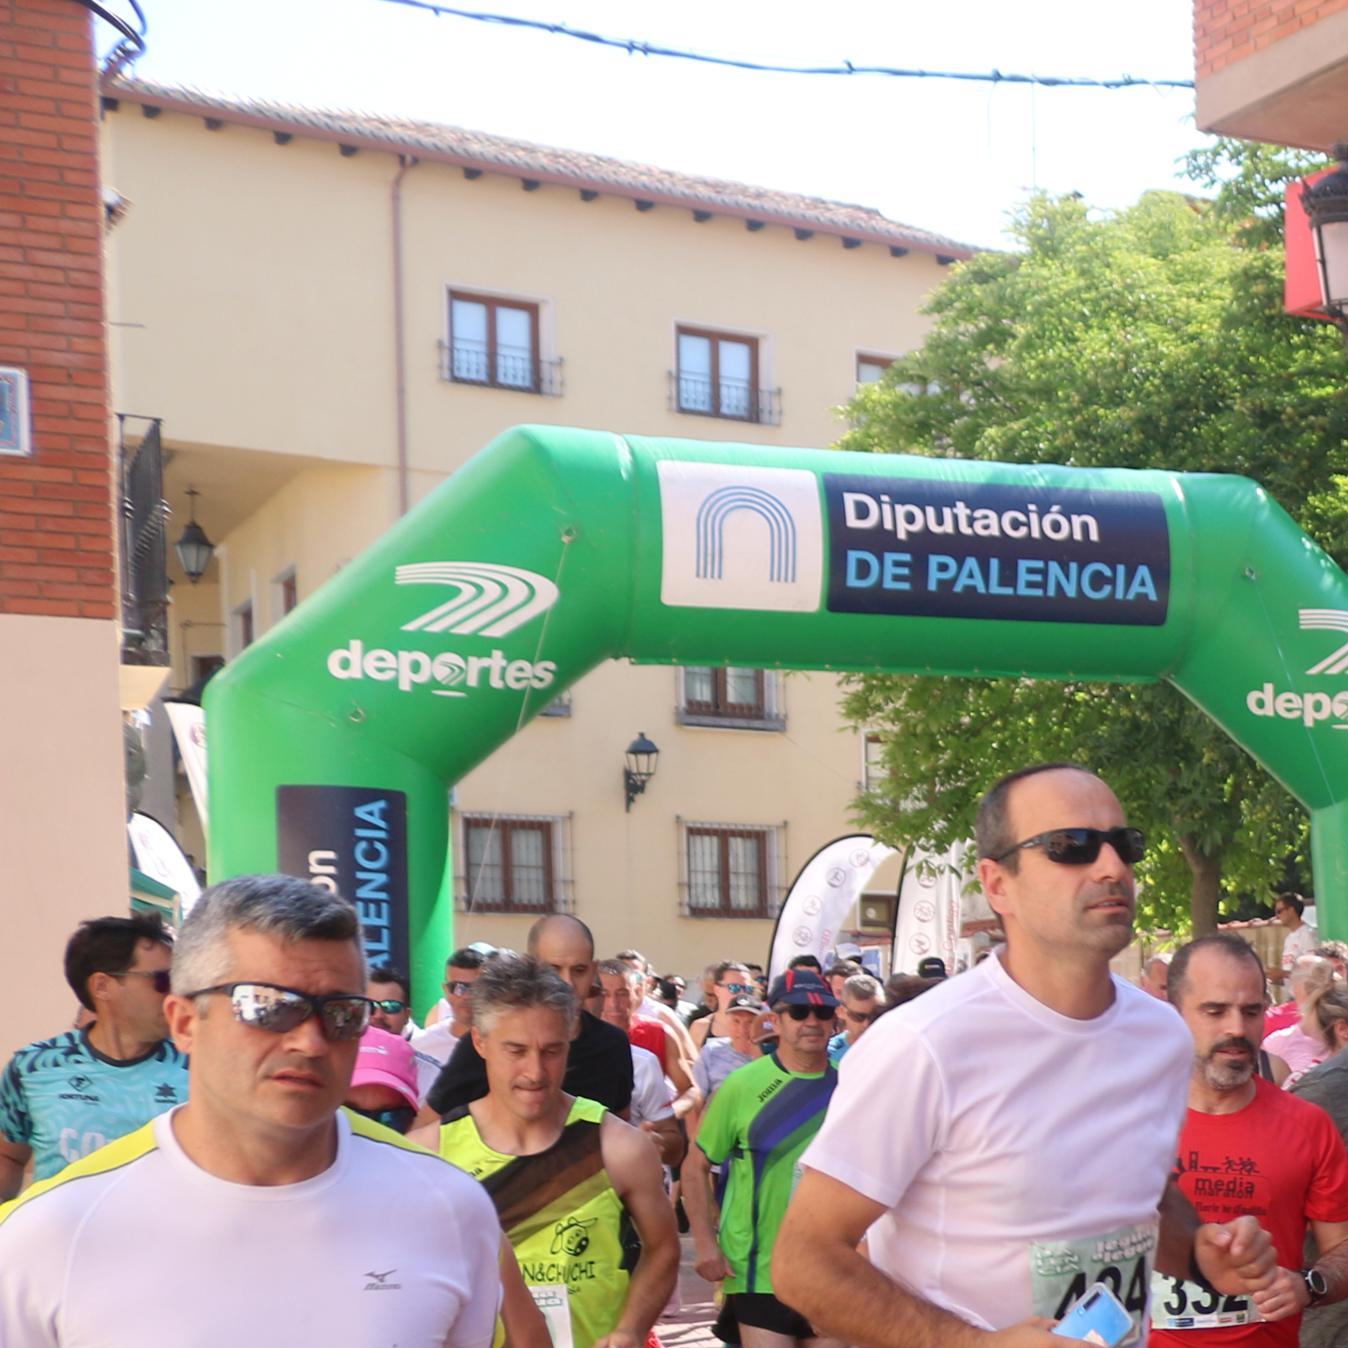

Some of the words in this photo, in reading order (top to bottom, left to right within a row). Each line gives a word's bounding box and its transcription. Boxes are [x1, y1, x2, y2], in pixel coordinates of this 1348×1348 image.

[842, 491, 1100, 541] Diputación
[845, 549, 912, 591] DE
[927, 553, 1158, 602] PALENCIA
[326, 639, 557, 692] deportes
[354, 799, 391, 970] ALENCIA
